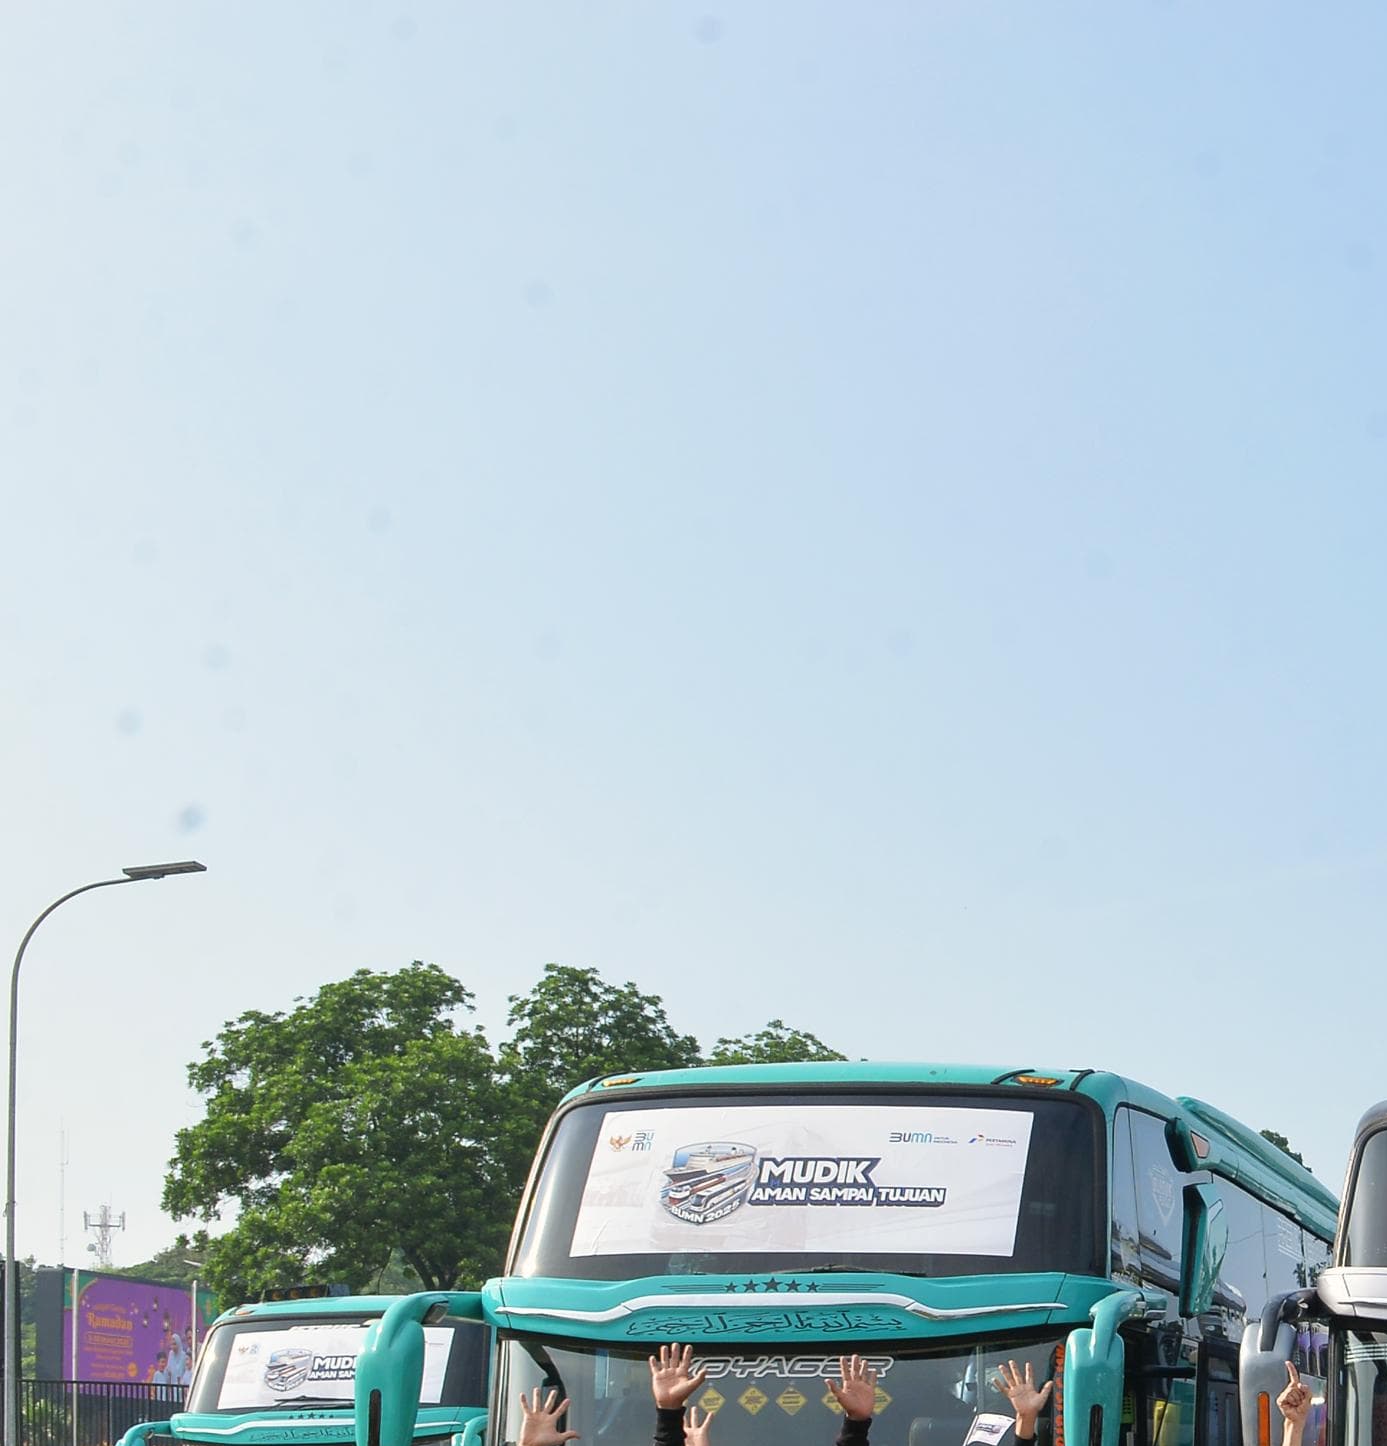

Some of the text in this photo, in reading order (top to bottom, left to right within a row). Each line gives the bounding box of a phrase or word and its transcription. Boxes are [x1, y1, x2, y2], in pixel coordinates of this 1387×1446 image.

[760, 1160, 871, 1184] MUDIK
[752, 1187, 945, 1202] AMAN SAMPAI TUJUAN
[671, 1206, 704, 1223] BUMN
[313, 1356, 357, 1371] MUDI
